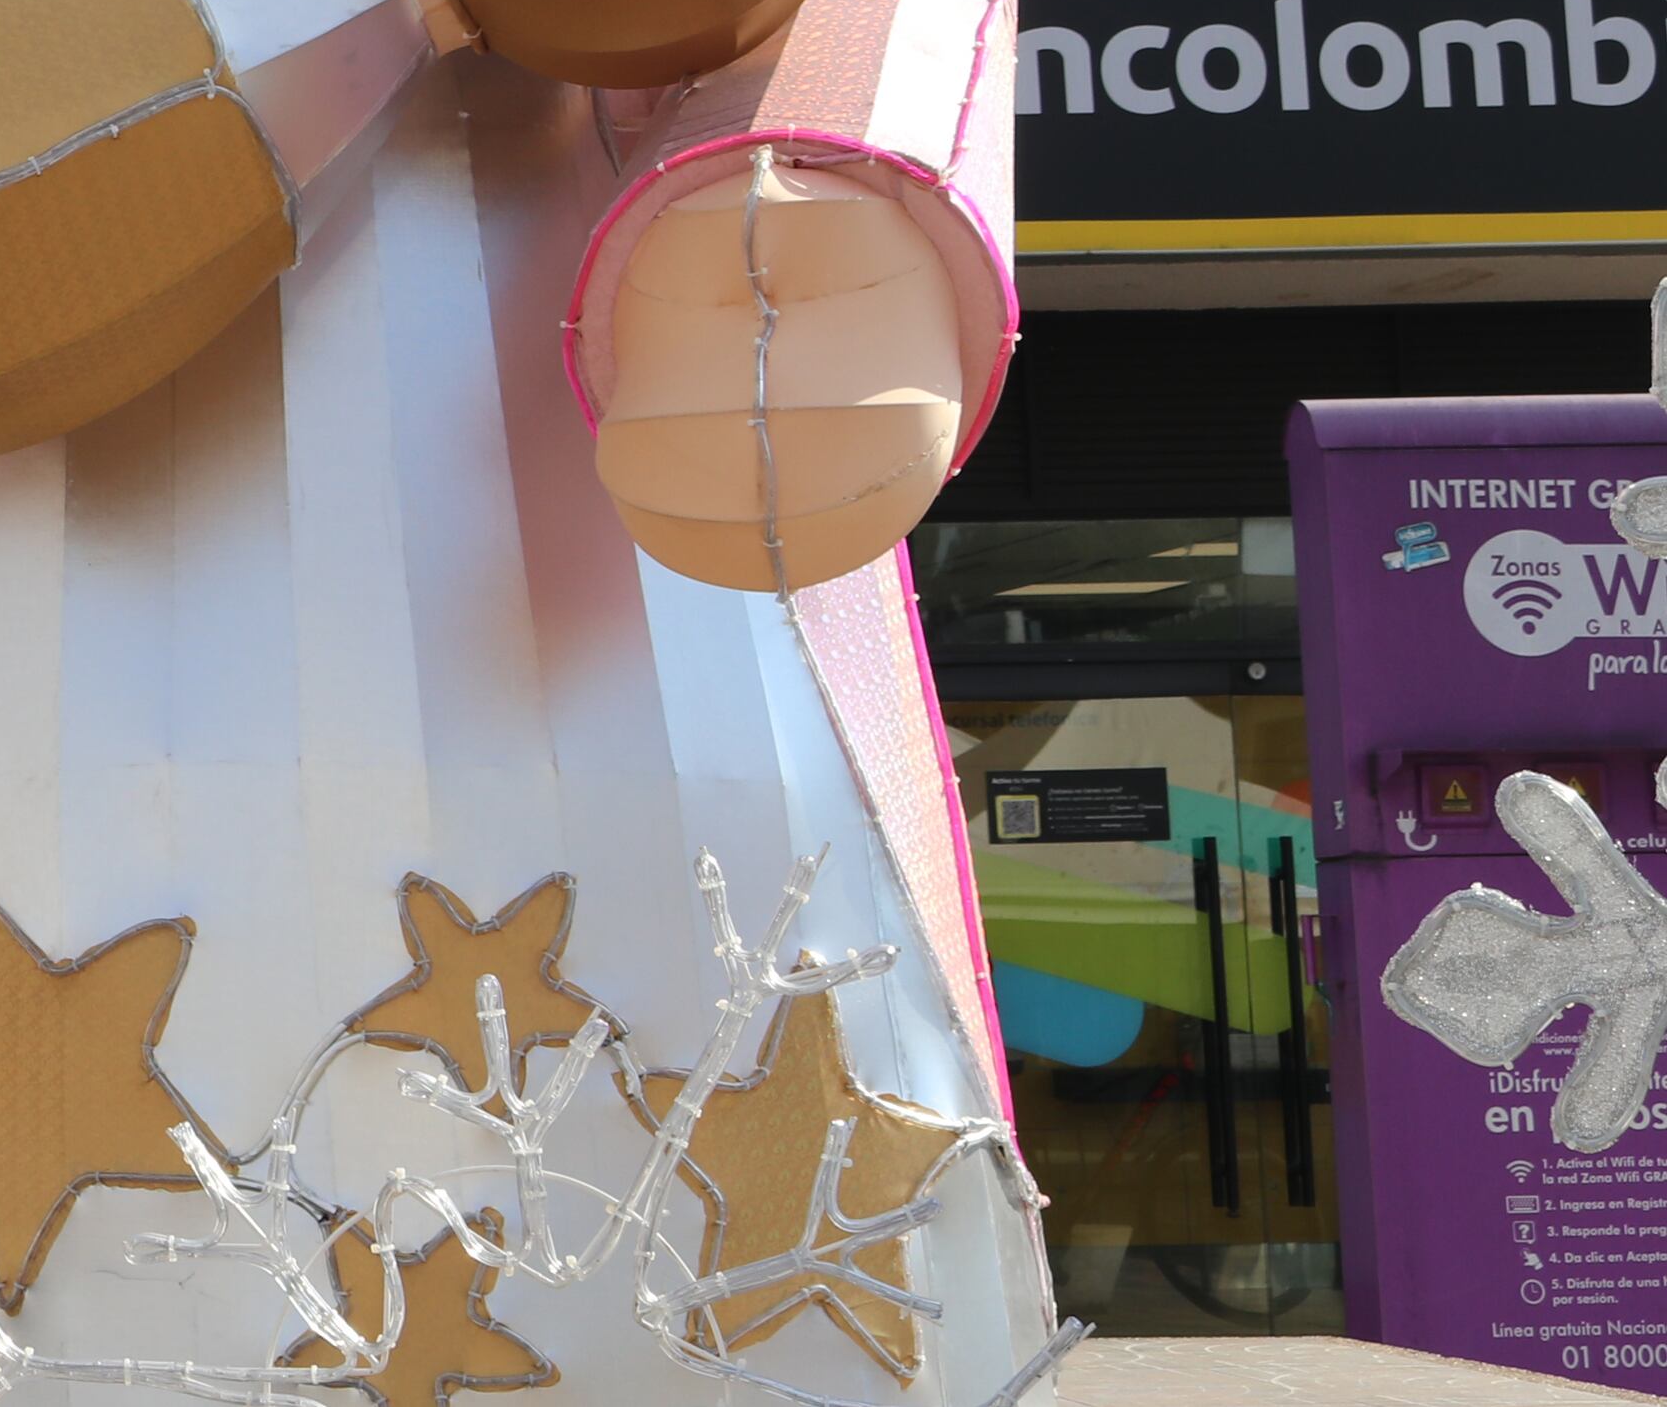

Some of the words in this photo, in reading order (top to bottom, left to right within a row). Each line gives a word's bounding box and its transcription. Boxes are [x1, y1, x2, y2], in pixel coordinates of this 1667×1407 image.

[1409, 479, 1576, 510] INTERNET
[1491, 554, 1562, 577] Zonas
[1582, 553, 1667, 616] W
[1587, 652, 1648, 691] para
[1485, 1105, 1535, 1133] en
[1542, 1158, 1553, 1170] 1.
[1556, 1157, 1593, 1169] Activa
[1596, 1157, 1607, 1168] el
[1610, 1156, 1635, 1167] Wifi
[1638, 1156, 1653, 1167] de
[1542, 1173, 1554, 1184] la
[1557, 1173, 1578, 1184] red
[1580, 1172, 1612, 1184] Zona
[1615, 1171, 1640, 1183] Wifi
[1544, 1199, 1556, 1211] 2.
[1560, 1199, 1605, 1212] Ingresa
[1608, 1200, 1624, 1209] en
[1547, 1226, 1559, 1237] 3.
[1562, 1224, 1621, 1238] Responde
[1624, 1224, 1636, 1235] la
[1639, 1226, 1667, 1238] preg
[1549, 1252, 1561, 1264] 4.
[1564, 1252, 1582, 1263] Da
[1585, 1251, 1604, 1263] clic
[1607, 1253, 1623, 1263] en
[1551, 1278, 1563, 1289] 5.
[1566, 1277, 1614, 1290] Disfruta
[1618, 1277, 1633, 1288] de
[1636, 1279, 1660, 1288] una
[1552, 1296, 1574, 1307] por
[1577, 1292, 1619, 1304] sesión.
[1492, 1321, 1534, 1338] Línea
[1539, 1321, 1601, 1342] gratuita
[1562, 1345, 1589, 1369] 01
[1604, 1344, 1667, 1369] 8000
